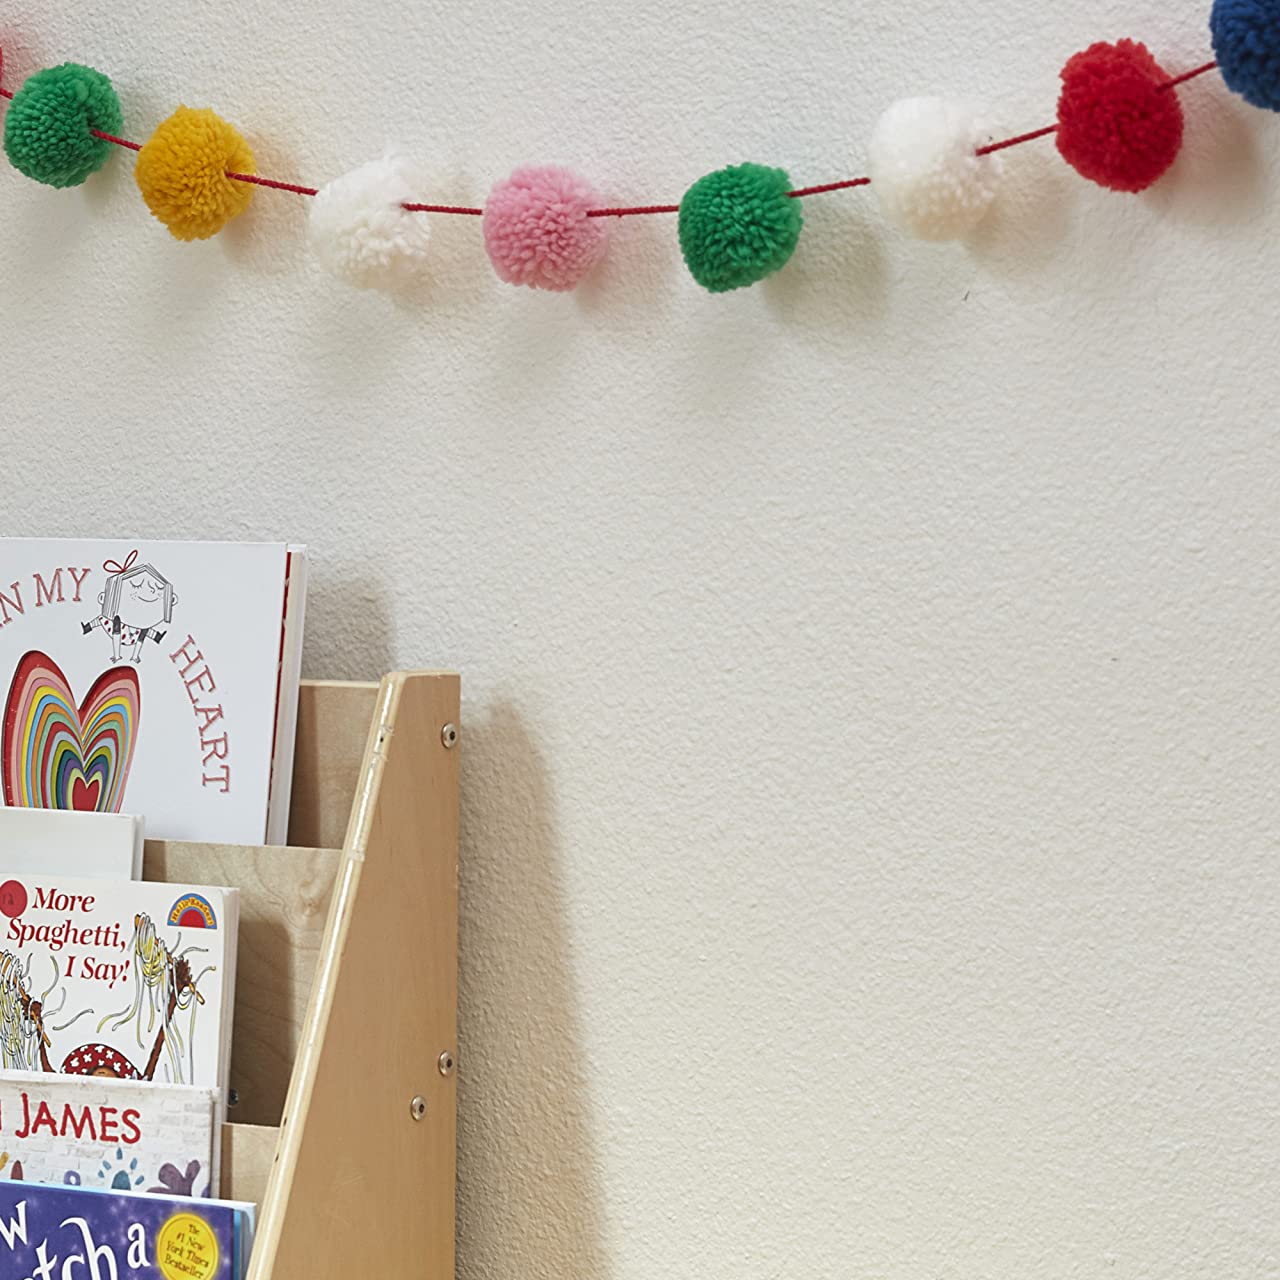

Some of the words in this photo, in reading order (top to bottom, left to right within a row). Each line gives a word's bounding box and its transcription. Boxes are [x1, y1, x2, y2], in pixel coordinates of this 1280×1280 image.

[32, 567, 91, 607] MY
[169, 634, 232, 795] HEART
[32, 886, 95, 913] More
[6, 917, 126, 953] Spaghetti,
[64, 955, 77, 977] I
[80, 956, 131, 990] Say!
[15, 1092, 142, 1145] JAMES
[127, 1222, 151, 1270] a
